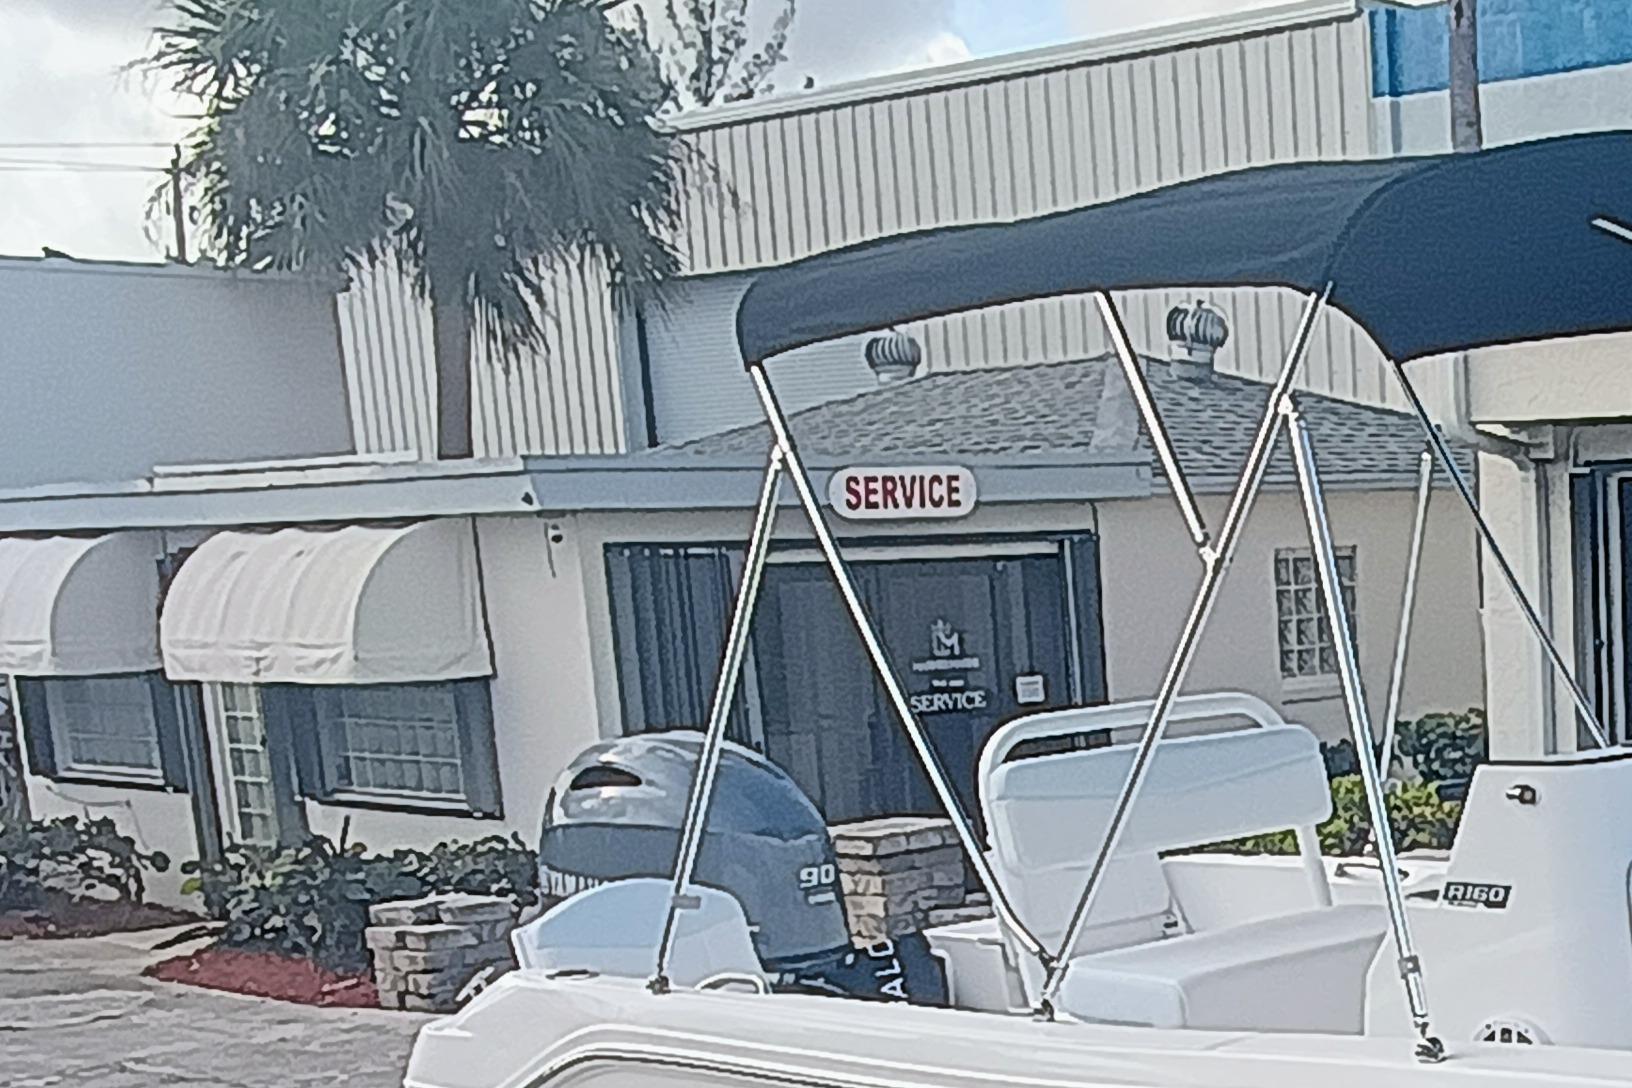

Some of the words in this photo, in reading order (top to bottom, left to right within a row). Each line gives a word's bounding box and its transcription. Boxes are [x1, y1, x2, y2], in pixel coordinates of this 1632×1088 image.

[845, 474, 962, 511] SERVICE
[910, 690, 988, 714] SERVICE
[799, 863, 836, 889] 90
[1448, 884, 1506, 902] R160
[866, 938, 909, 999] ALO
